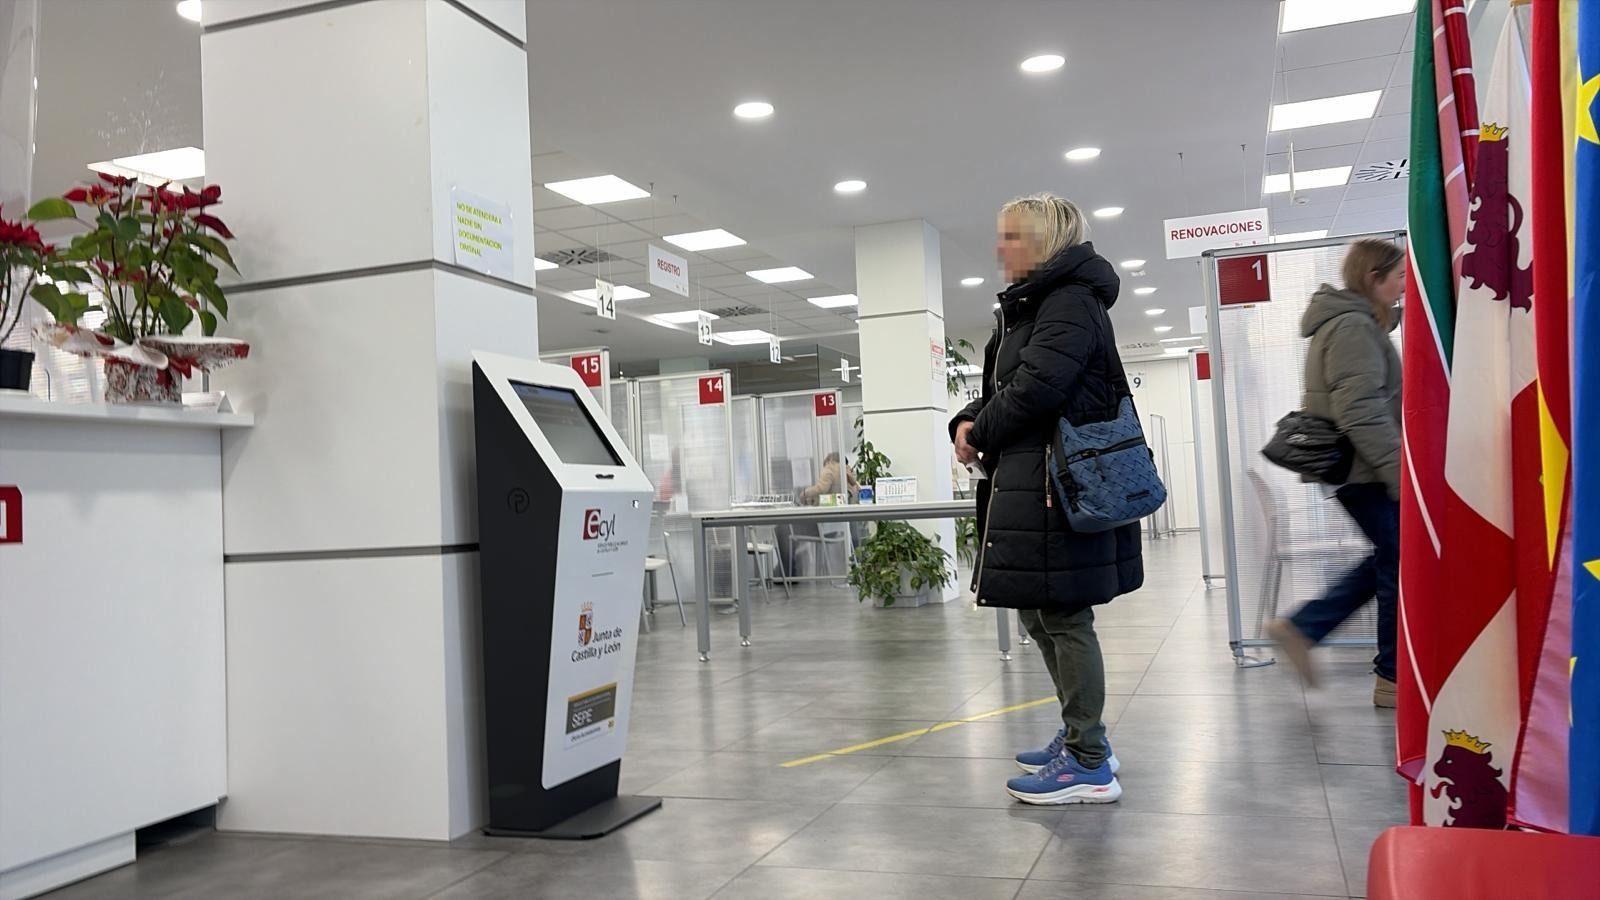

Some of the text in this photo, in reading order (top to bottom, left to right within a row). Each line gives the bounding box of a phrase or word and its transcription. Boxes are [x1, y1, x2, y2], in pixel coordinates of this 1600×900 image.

[1171, 220, 1263, 240] RENOVACIONES
[656, 258, 681, 277] REGISTRO
[1252, 259, 1262, 280] 1
[600, 294, 614, 317] 14
[700, 324, 711, 344] 13
[771, 345, 780, 362] 12
[581, 357, 599, 374] 15
[707, 378, 723, 392] 14
[1133, 377, 1142, 389] 9
[821, 394, 835, 407] 13
[966, 388, 980, 400] 10
[586, 510, 616, 542] ecyl
[592, 626, 622, 643] Junta de
[571, 647, 597, 662] Castilla
[604, 641, 621, 655] León
[571, 708, 593, 729] SEPE
